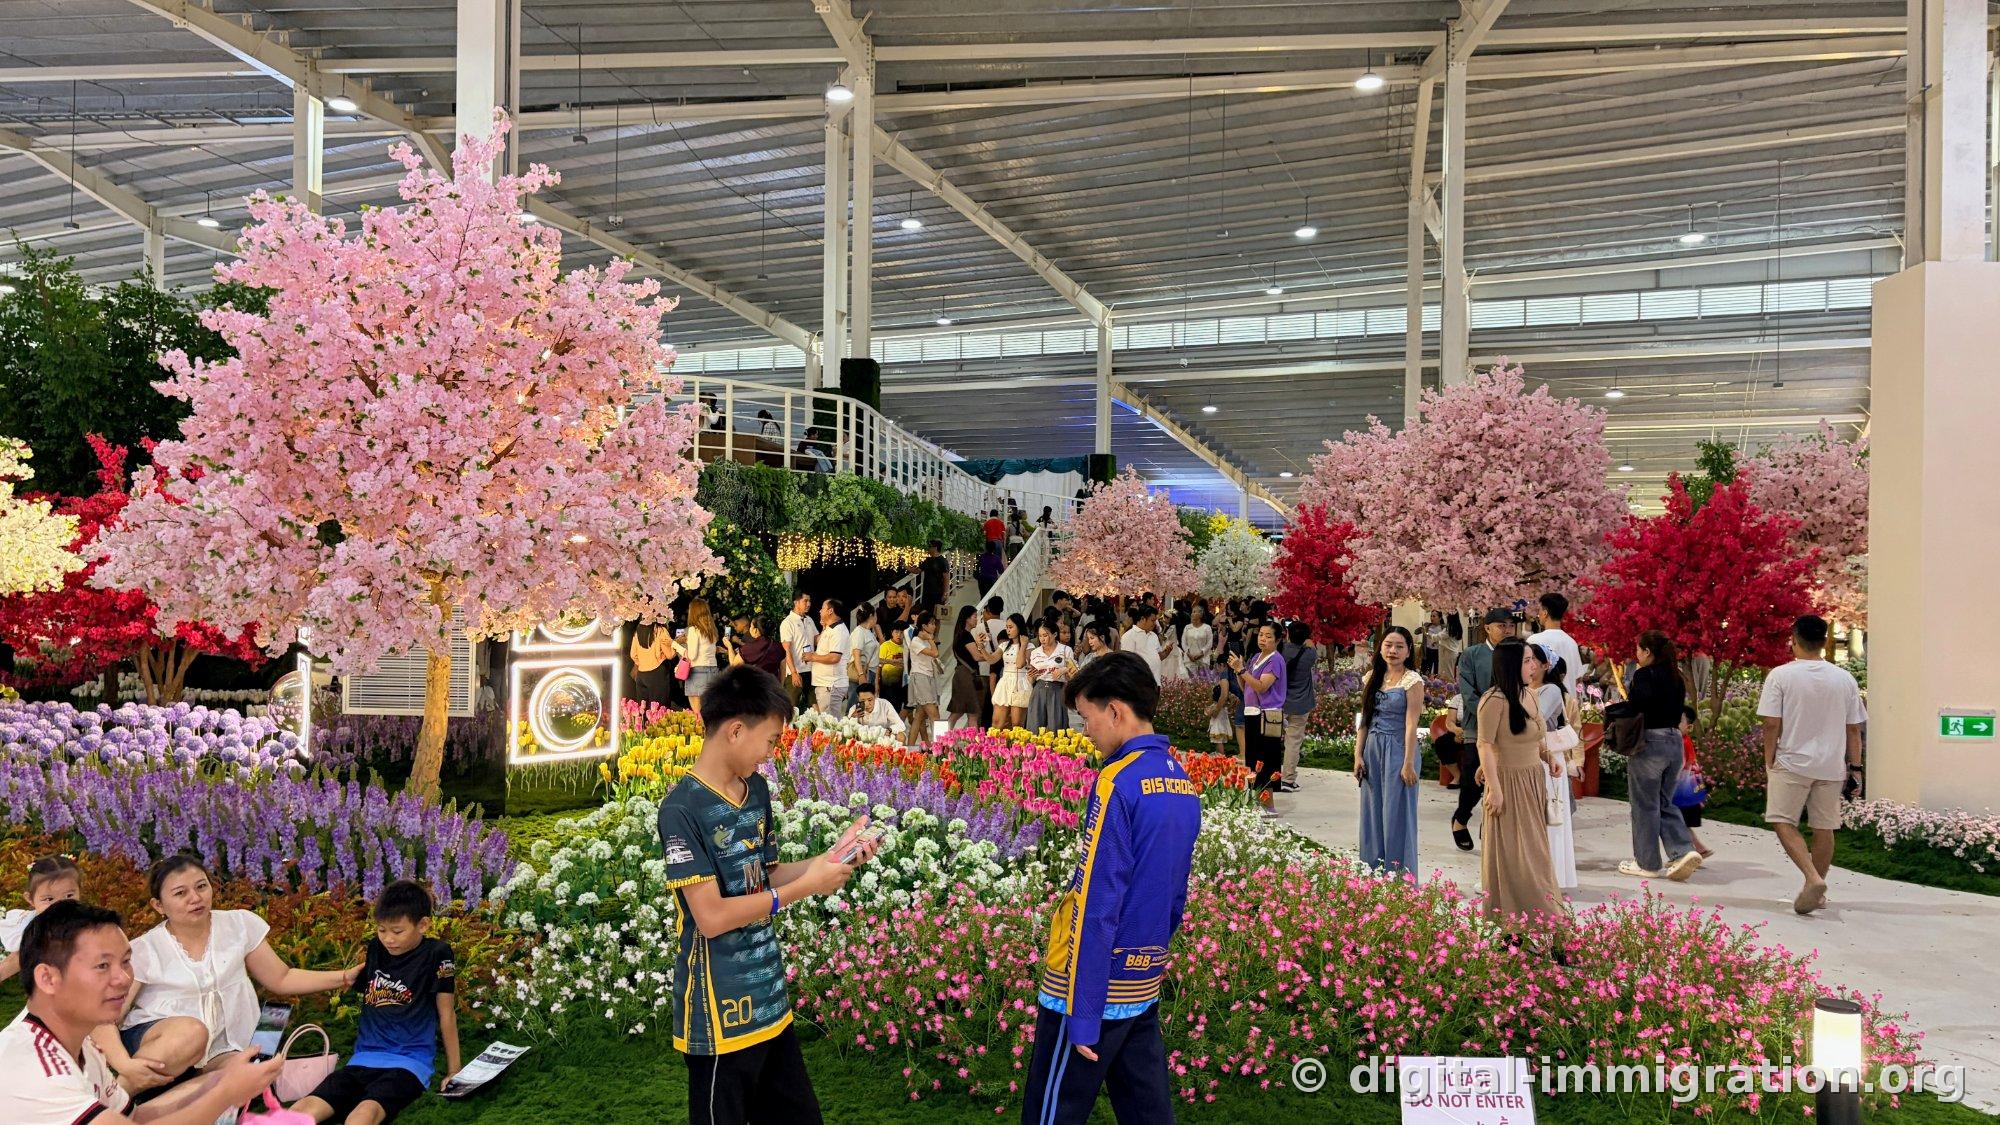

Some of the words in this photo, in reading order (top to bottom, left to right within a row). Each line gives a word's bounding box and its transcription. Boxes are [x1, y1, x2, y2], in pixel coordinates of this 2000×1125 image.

[1141, 777, 1165, 794] BIS
[1125, 954, 1151, 967] BBB
[721, 995, 753, 1028] 20
[1438, 1095, 1471, 1108] NOT
[1476, 1095, 1525, 1108] ENTER
